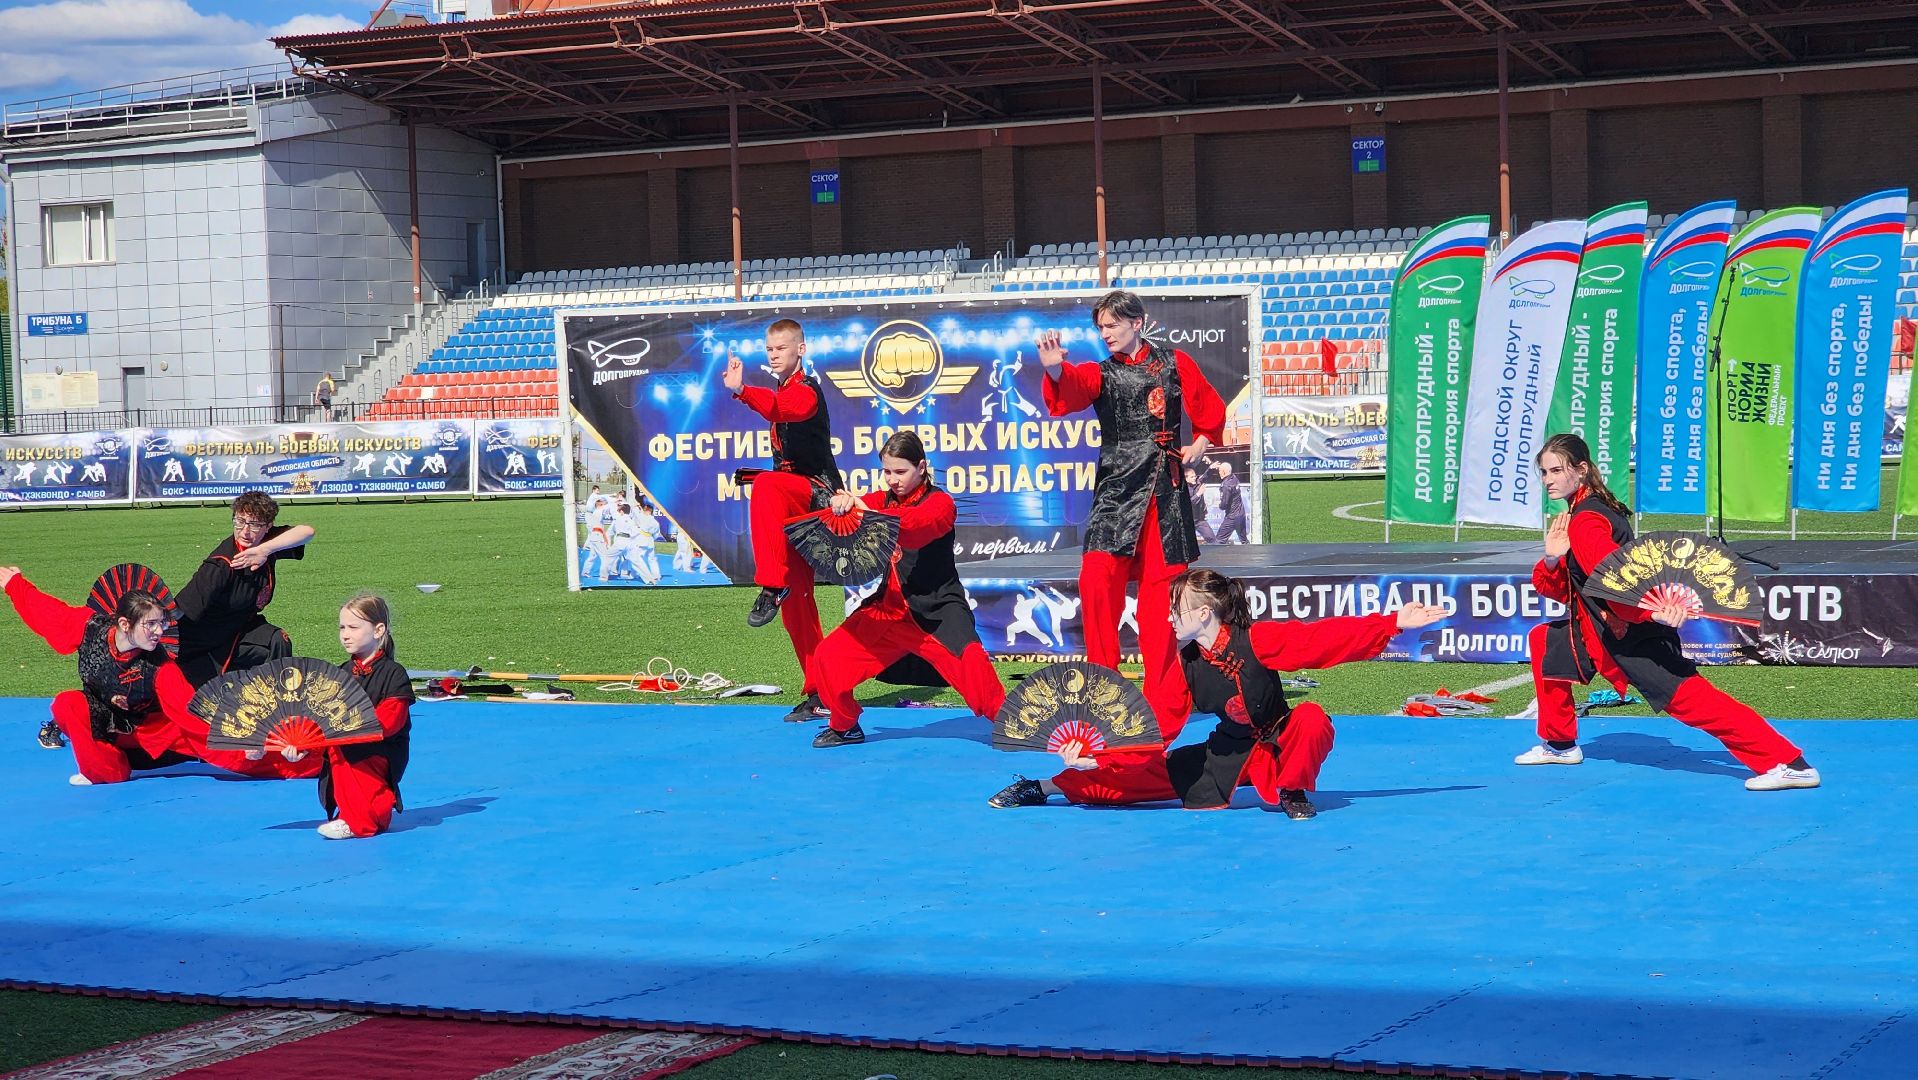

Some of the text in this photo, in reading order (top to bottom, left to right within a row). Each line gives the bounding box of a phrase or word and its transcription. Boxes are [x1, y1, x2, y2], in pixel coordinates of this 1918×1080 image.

[1352, 140, 1385, 150] СЕКТОР
[1366, 151, 1372, 159] 2
[811, 174, 839, 183] СЕКТОР
[31, 315, 83, 326] ТРИБУНА Б
[1168, 328, 1227, 349] САЛЮТ
[1601, 308, 1618, 377] спорта
[1658, 308, 1687, 492] Ни дня без спорта,
[1683, 300, 1708, 492] Ни дня без победы!
[1726, 370, 1738, 421] СПОРТ
[1737, 361, 1756, 423] НОРМА
[1751, 362, 1772, 424] ЖИЗНИ
[1817, 302, 1848, 490] Ни дня без спорта,
[1840, 294, 1873, 490] Ни дня без победы!
[1414, 335, 1436, 503] ДОЛГОПРУДНЫЙ
[1443, 318, 1461, 503] территория спорта
[1488, 319, 1523, 502] ГОРОДСКОЙ ОКРУГ
[1512, 343, 1542, 505] ДОЛГОПРУДНЫЙ
[1777, 394, 1787, 426] ПРОЕКТ
[184, 440, 276, 456] ФЕСТИВАЛЬ
[279, 439, 340, 454] БОЕВЫХ
[344, 436, 422, 452] ИСКУССТВ
[527, 433, 561, 449] ФЕС
[852, 420, 989, 455] БОВЫХ
[1332, 435, 1378, 448] МОСКОВСКАЯ
[5, 446, 83, 461] ИСКУССТВ
[267, 456, 341, 474] МОСКОВСКАЯ ОБЛАСТЬ
[1315, 459, 1350, 469] КАРАТЕ
[162, 487, 185, 496] БОКС
[190, 485, 246, 495] КИКБОКСИНГ
[321, 484, 354, 493] ДЗЮДО
[359, 482, 410, 492] ТХЭКВОНДО
[416, 480, 446, 490] САМБО
[504, 480, 527, 489] БОКС
[945, 461, 1097, 494] ОБЛАСТИ
[21, 490, 70, 500] ТХЭКВОНДО
[76, 489, 106, 498] САМБО
[970, 531, 1062, 561] первым!
[1244, 582, 1843, 621] ФЕСТИВАЛЬ БОЕВ СТВ
[1438, 628, 1532, 658] Долгоп
[1806, 645, 1862, 664] САЛЮТ
